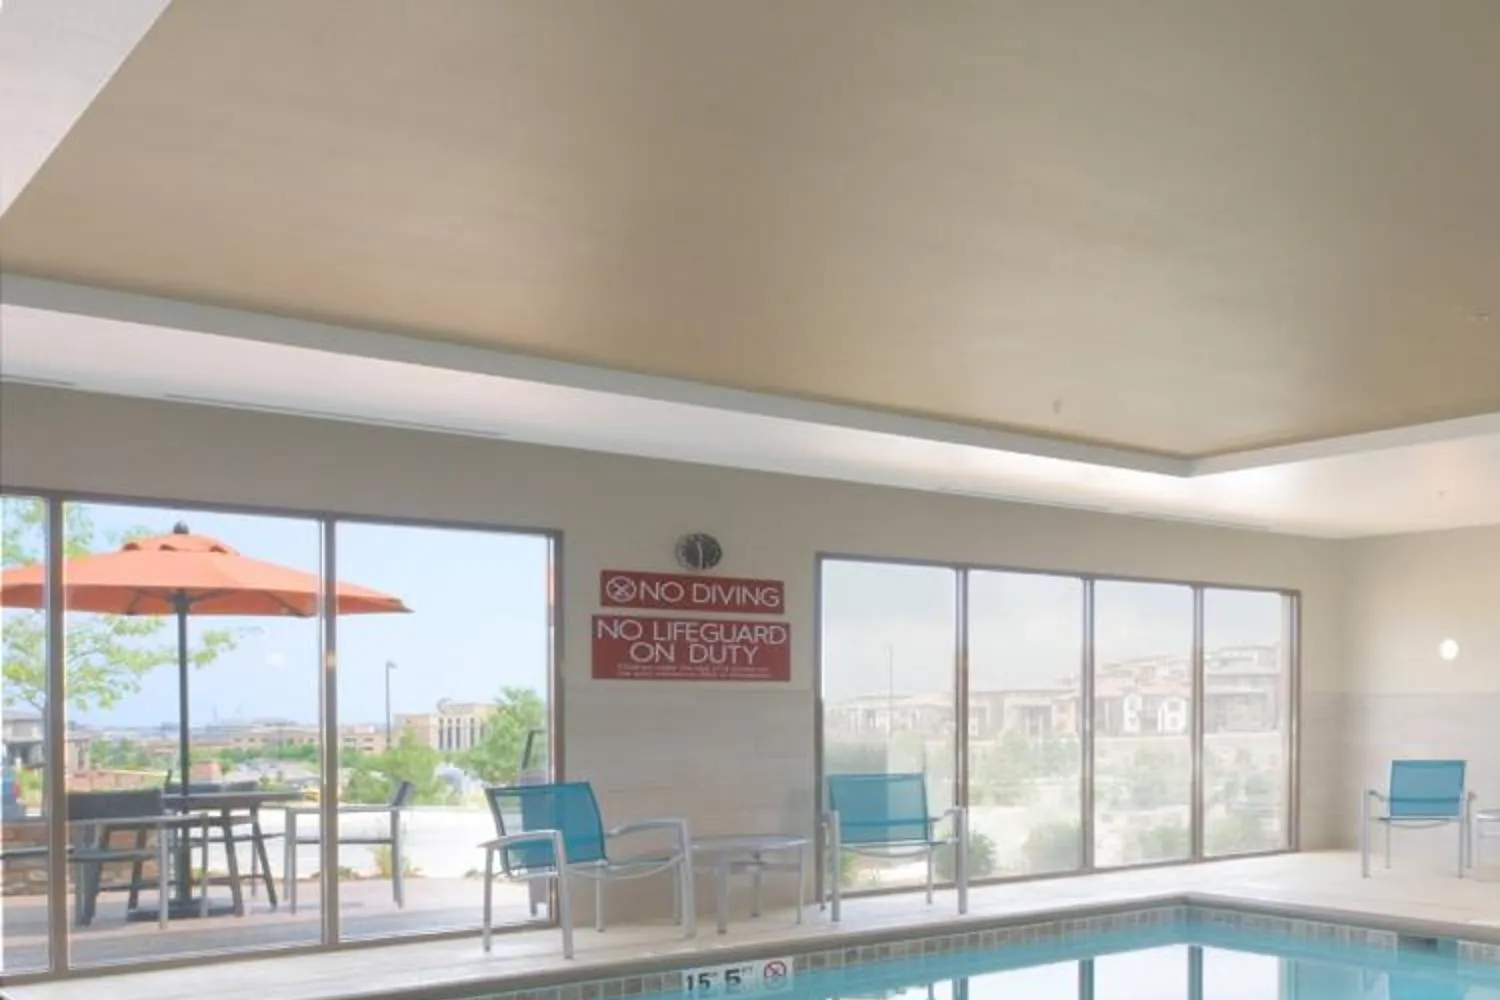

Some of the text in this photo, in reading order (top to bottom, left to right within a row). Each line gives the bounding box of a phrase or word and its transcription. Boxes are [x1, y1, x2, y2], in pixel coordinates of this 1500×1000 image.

[640, 580, 780, 607] NO DIVING
[597, 618, 787, 645] NO LIFEGUARD
[629, 641, 759, 665] ON DUTY
